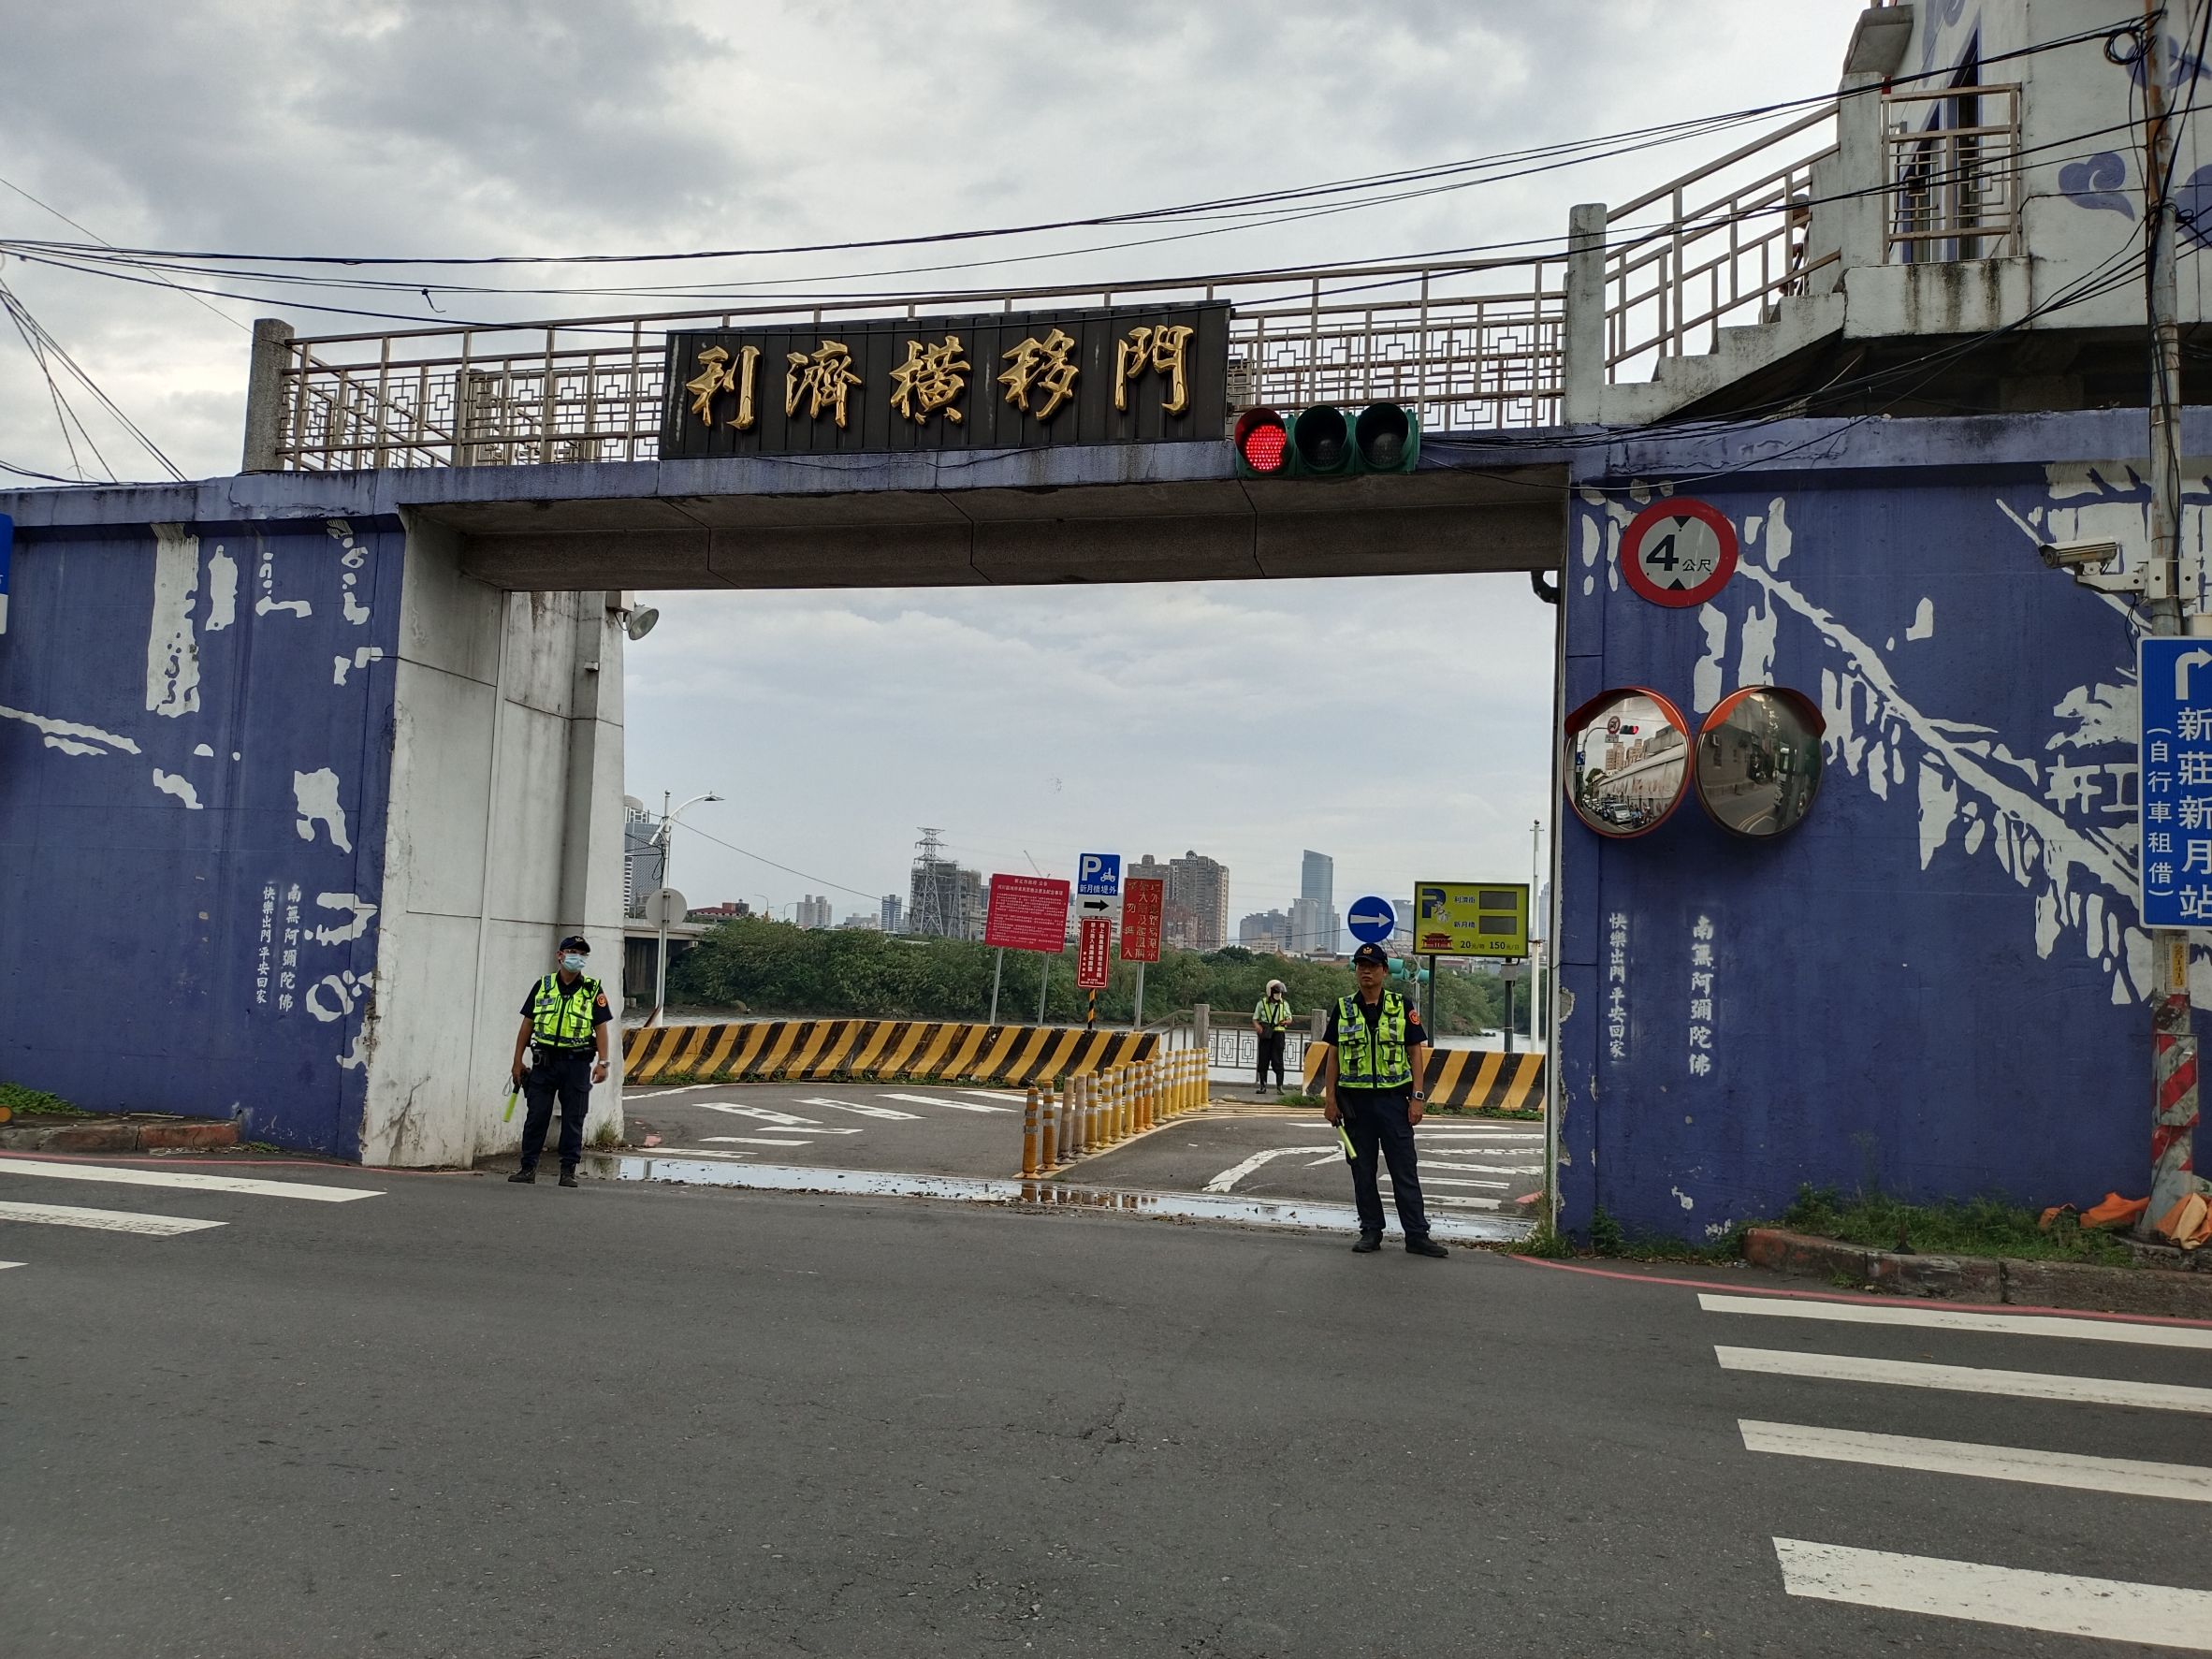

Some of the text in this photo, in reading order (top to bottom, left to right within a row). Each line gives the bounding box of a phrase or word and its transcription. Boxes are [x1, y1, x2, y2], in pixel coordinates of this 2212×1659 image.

[686, 325, 1194, 430] 利濟橫移門
[1082, 856, 1101, 880] P
[2176, 706, 2212, 919] 新莊新月站
[256, 886, 276, 1004] 快樂出門 平安回家
[278, 883, 301, 1012] 南無阿彌陀佛
[1608, 912, 1628, 1057] 快樂出門 平安回家
[1689, 915, 1714, 1076] 南無阿彌陀佛
